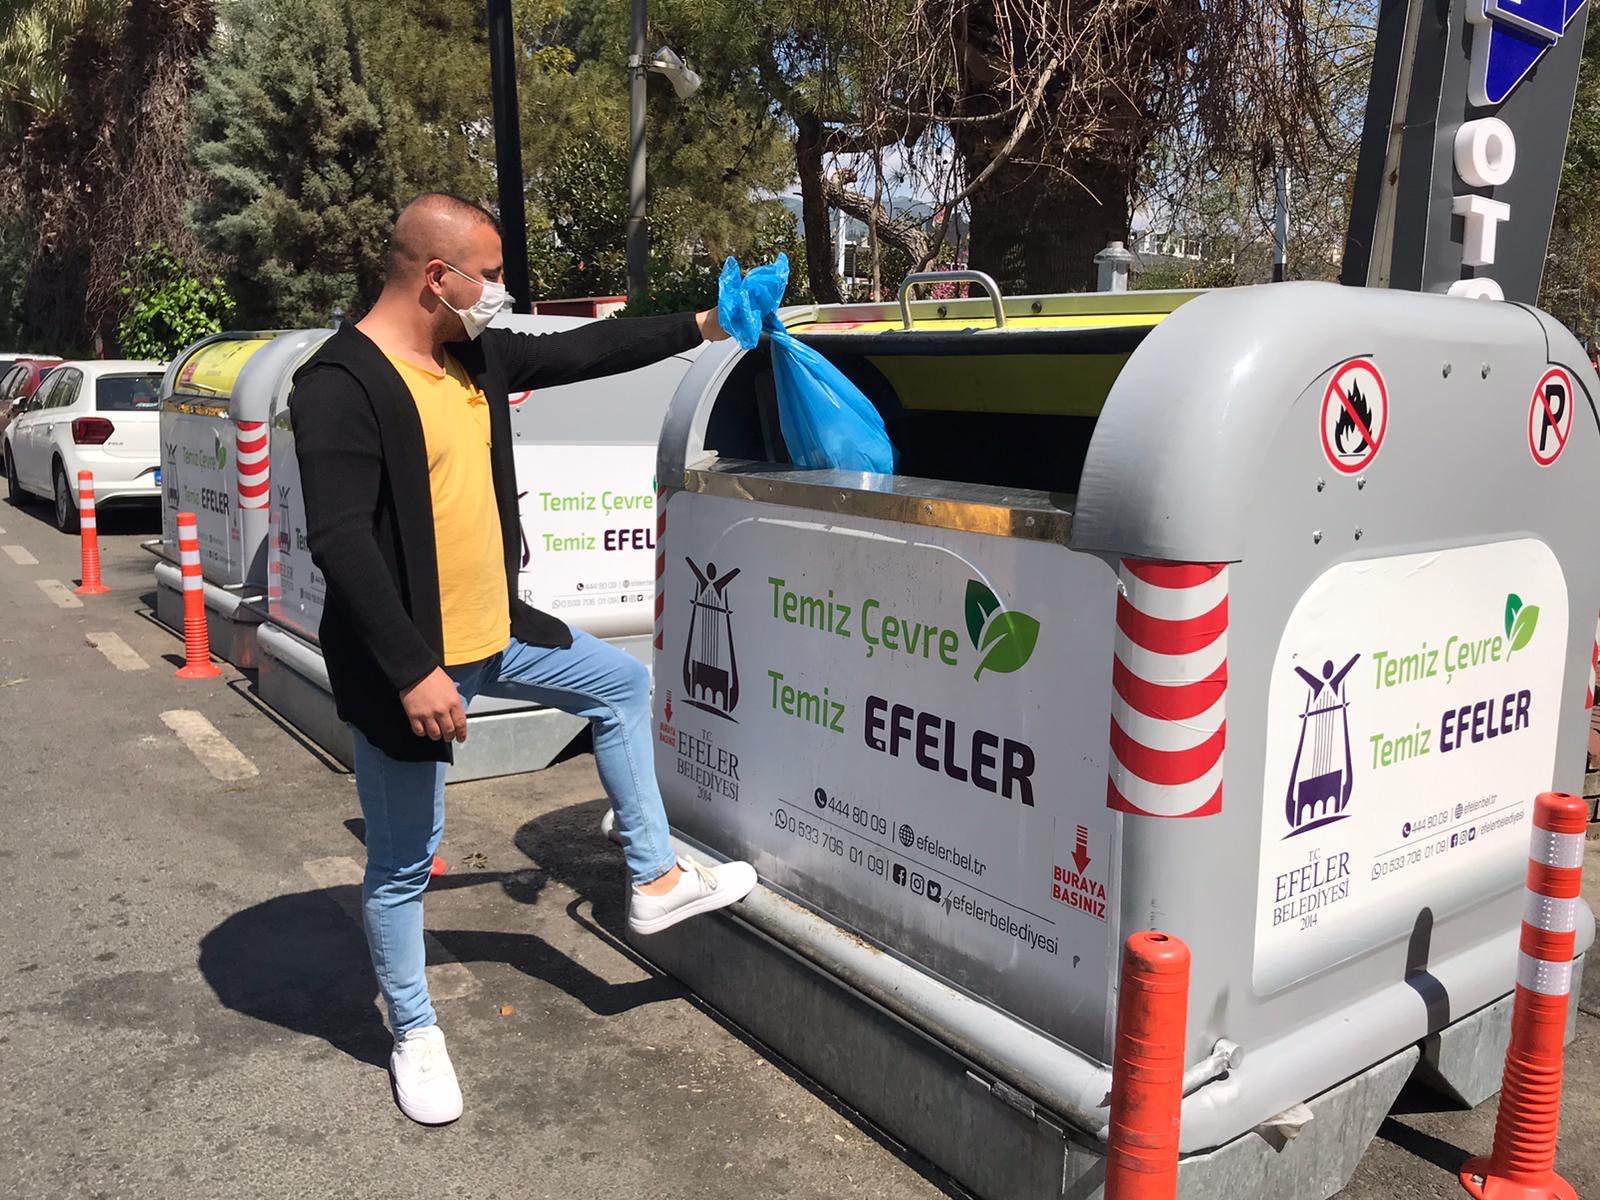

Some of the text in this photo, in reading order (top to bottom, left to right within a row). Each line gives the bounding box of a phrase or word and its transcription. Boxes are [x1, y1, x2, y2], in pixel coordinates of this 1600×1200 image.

[201, 487, 230, 516] EFELER
[539, 491, 654, 516] Temiz Çevre
[542, 532, 596, 552] Temiz
[768, 576, 959, 666] Temiz Çevre
[1372, 635, 1502, 690] Temiz Çevre
[767, 669, 1036, 808] Temiz EFELER
[1370, 689, 1532, 770] Temiz EFELER
[678, 730, 740, 781] EFELER
[677, 758, 740, 802] BELEDİYESİ
[828, 796, 987, 877] 444 80 09 efeler.bel.tr
[1412, 818, 1426, 832] 444
[1427, 814, 1438, 828] 80
[1438, 810, 1449, 825] 09
[788, 816, 796, 833] 0
[798, 822, 819, 845] 533
[822, 832, 844, 856] 706
[849, 846, 864, 867] 01
[868, 854, 884, 876] 09
[1382, 862, 1388, 876] 0
[1389, 856, 1406, 873] 533
[1406, 850, 1422, 866] 706
[1424, 844, 1434, 858] 01
[1435, 840, 1446, 854] 09
[1053, 864, 1106, 901] BURAYA
[1274, 851, 1351, 904] EFELER
[1052, 884, 1106, 920] BASINIZ
[1272, 878, 1350, 927] BELEDİYESİ
[1300, 912, 1318, 931] 2014
